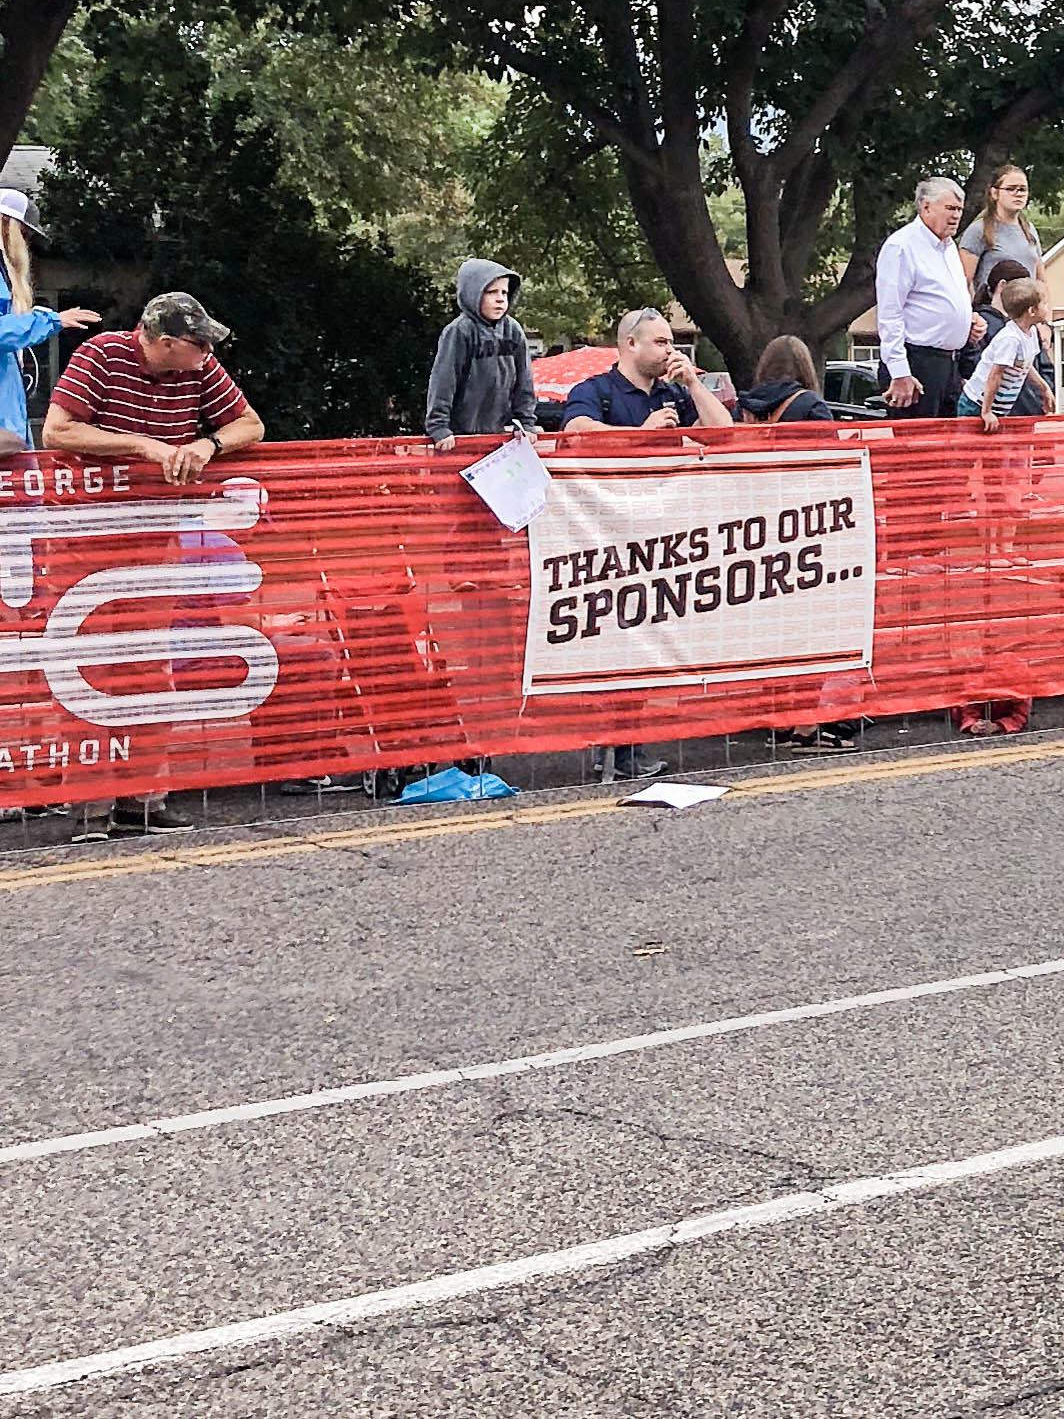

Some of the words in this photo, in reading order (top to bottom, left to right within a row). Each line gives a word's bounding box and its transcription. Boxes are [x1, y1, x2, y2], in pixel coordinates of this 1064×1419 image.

[543, 527, 709, 593] THANKS
[718, 516, 767, 556] TO
[778, 497, 856, 543] OUR
[546, 544, 863, 644] SPONSORS...
